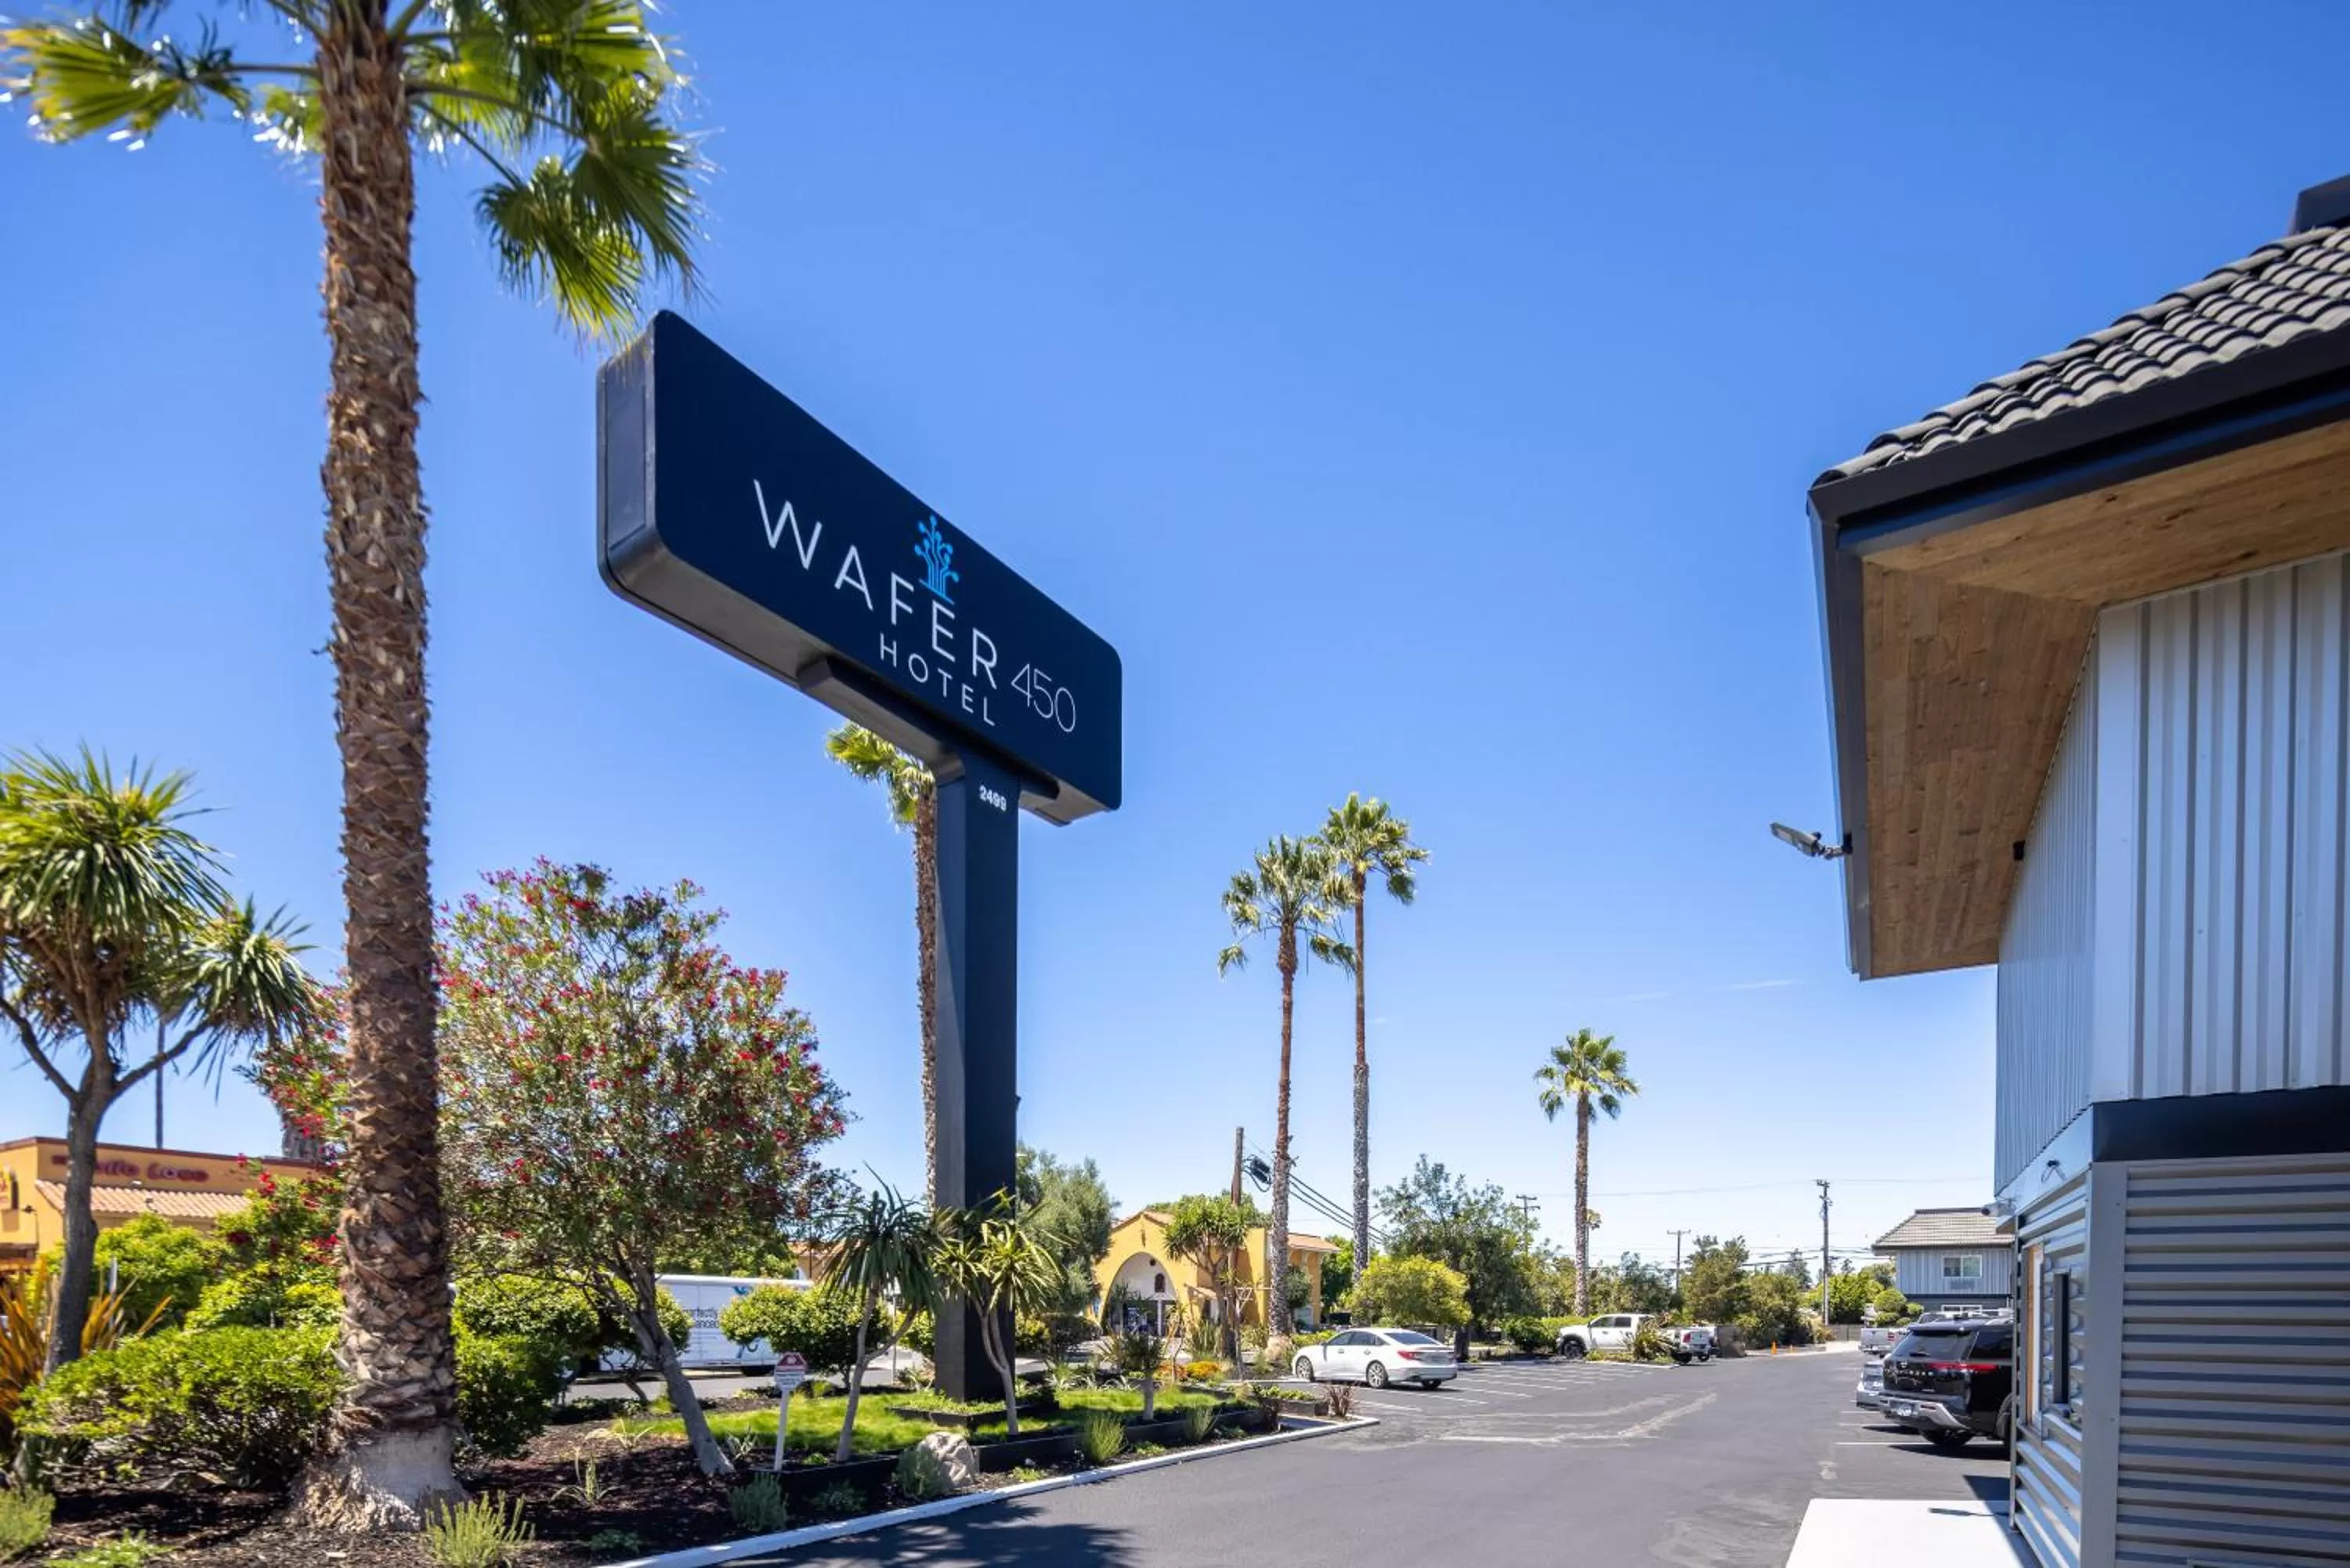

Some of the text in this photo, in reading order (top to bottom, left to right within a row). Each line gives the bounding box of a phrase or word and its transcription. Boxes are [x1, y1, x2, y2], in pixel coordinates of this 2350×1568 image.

[754, 479, 1077, 733] WAFER 450
[880, 632, 996, 727] HOTEL
